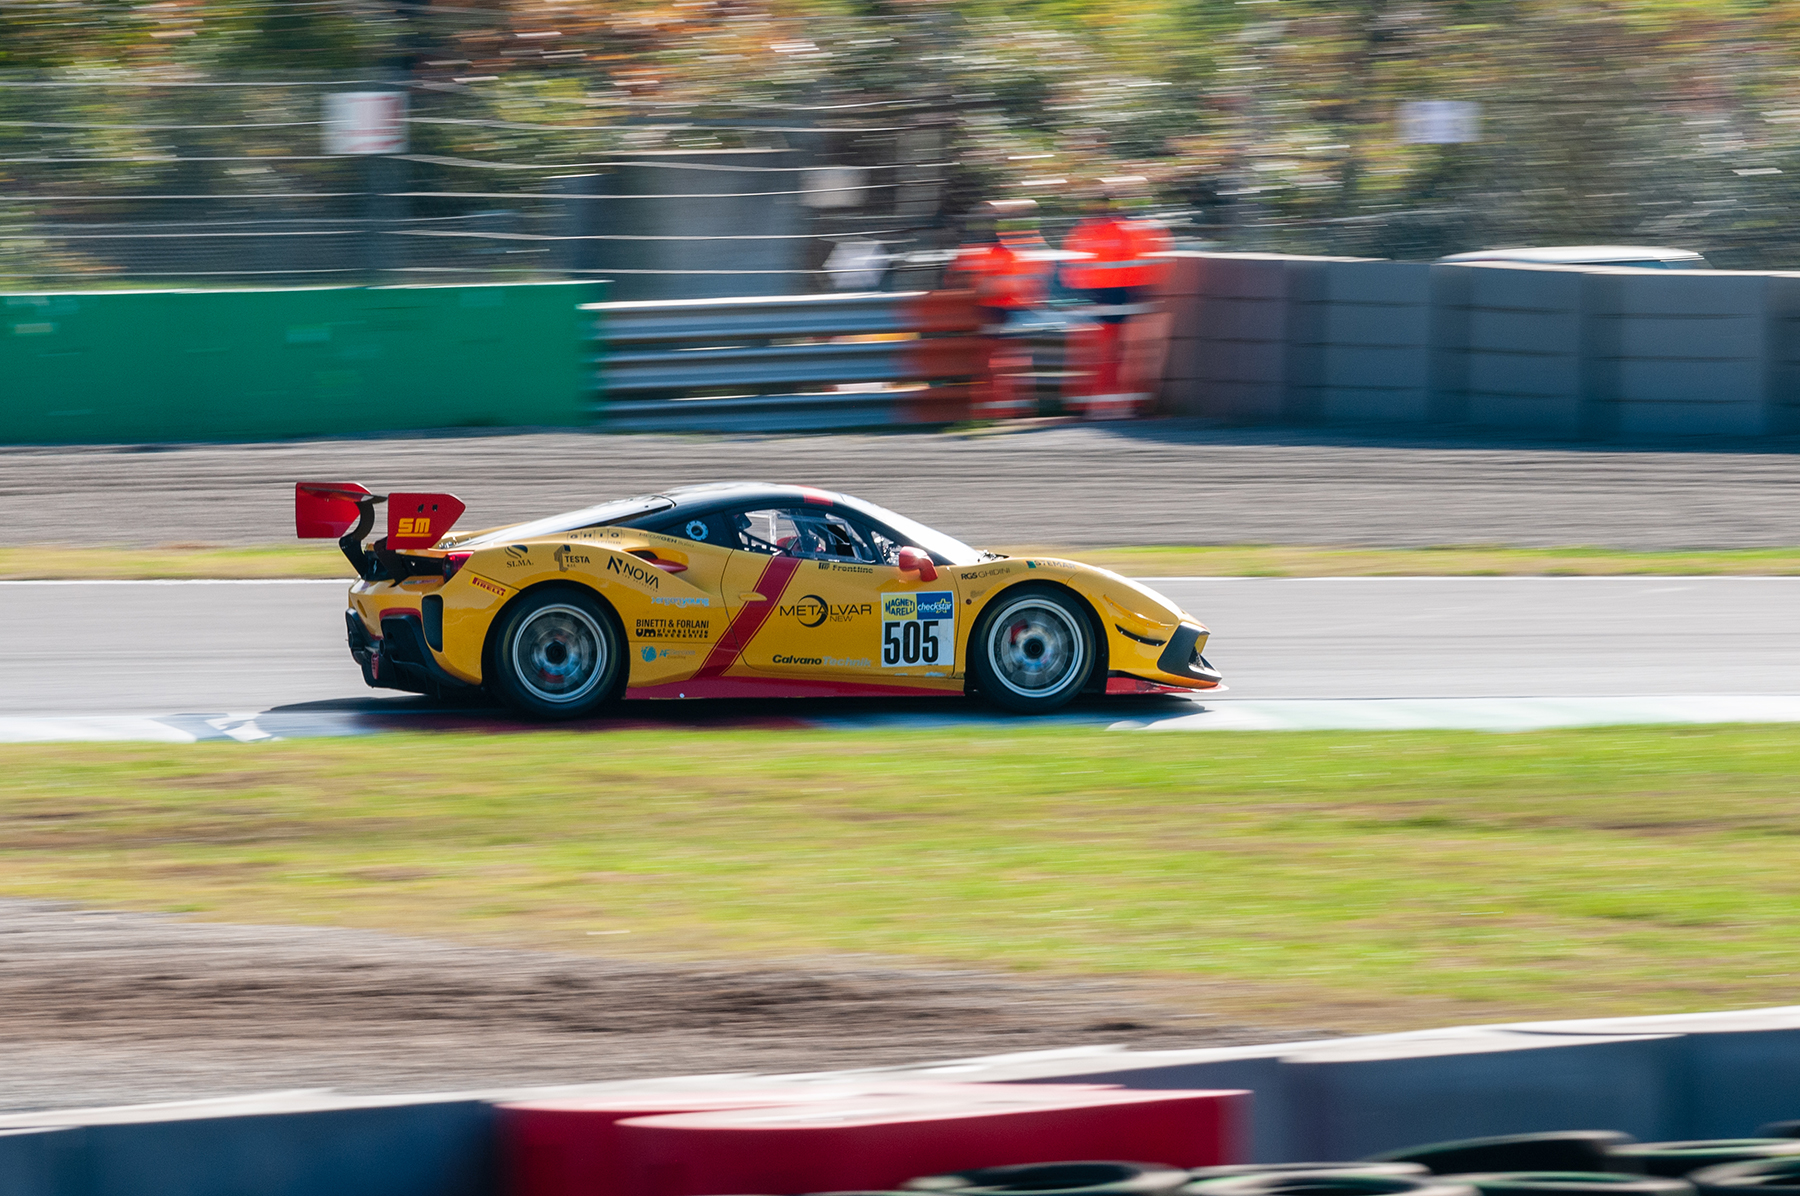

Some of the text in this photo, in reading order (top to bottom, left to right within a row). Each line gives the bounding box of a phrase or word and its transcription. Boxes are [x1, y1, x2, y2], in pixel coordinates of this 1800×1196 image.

[398, 517, 430, 533] SM
[565, 555, 590, 564] TESTA
[832, 564, 873, 574] Frontline
[623, 562, 659, 589] NOVA
[472, 576, 506, 596] PIRELLI
[779, 604, 872, 616] METALVAR
[917, 601, 952, 612] checkstar
[636, 619, 667, 627] BINETTI
[676, 620, 709, 628] FORLANI
[884, 621, 939, 665] 505
